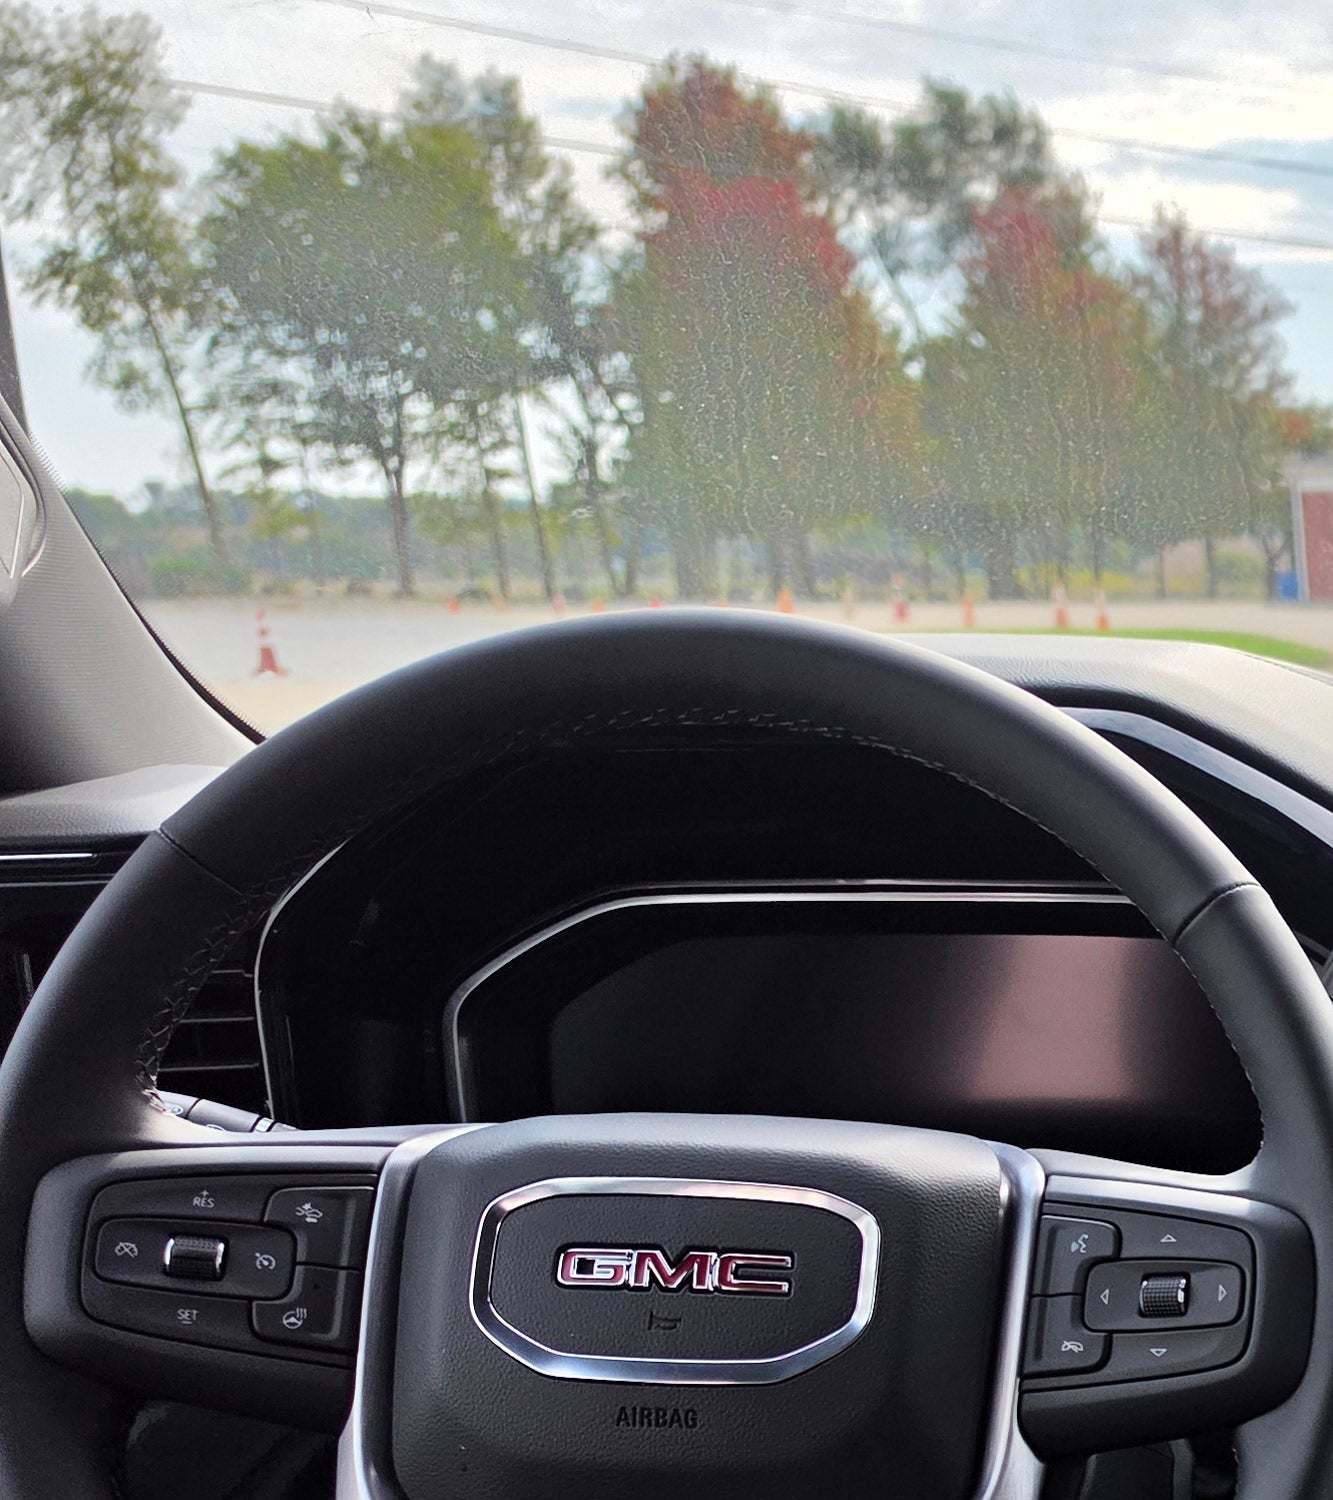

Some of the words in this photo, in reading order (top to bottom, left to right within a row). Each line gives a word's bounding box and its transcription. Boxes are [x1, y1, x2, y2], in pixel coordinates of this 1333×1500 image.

[193, 1196, 215, 1208] RES
[557, 1248, 792, 1294] GMC
[177, 1308, 199, 1320] SET
[615, 1406, 698, 1429] AIRBAG
